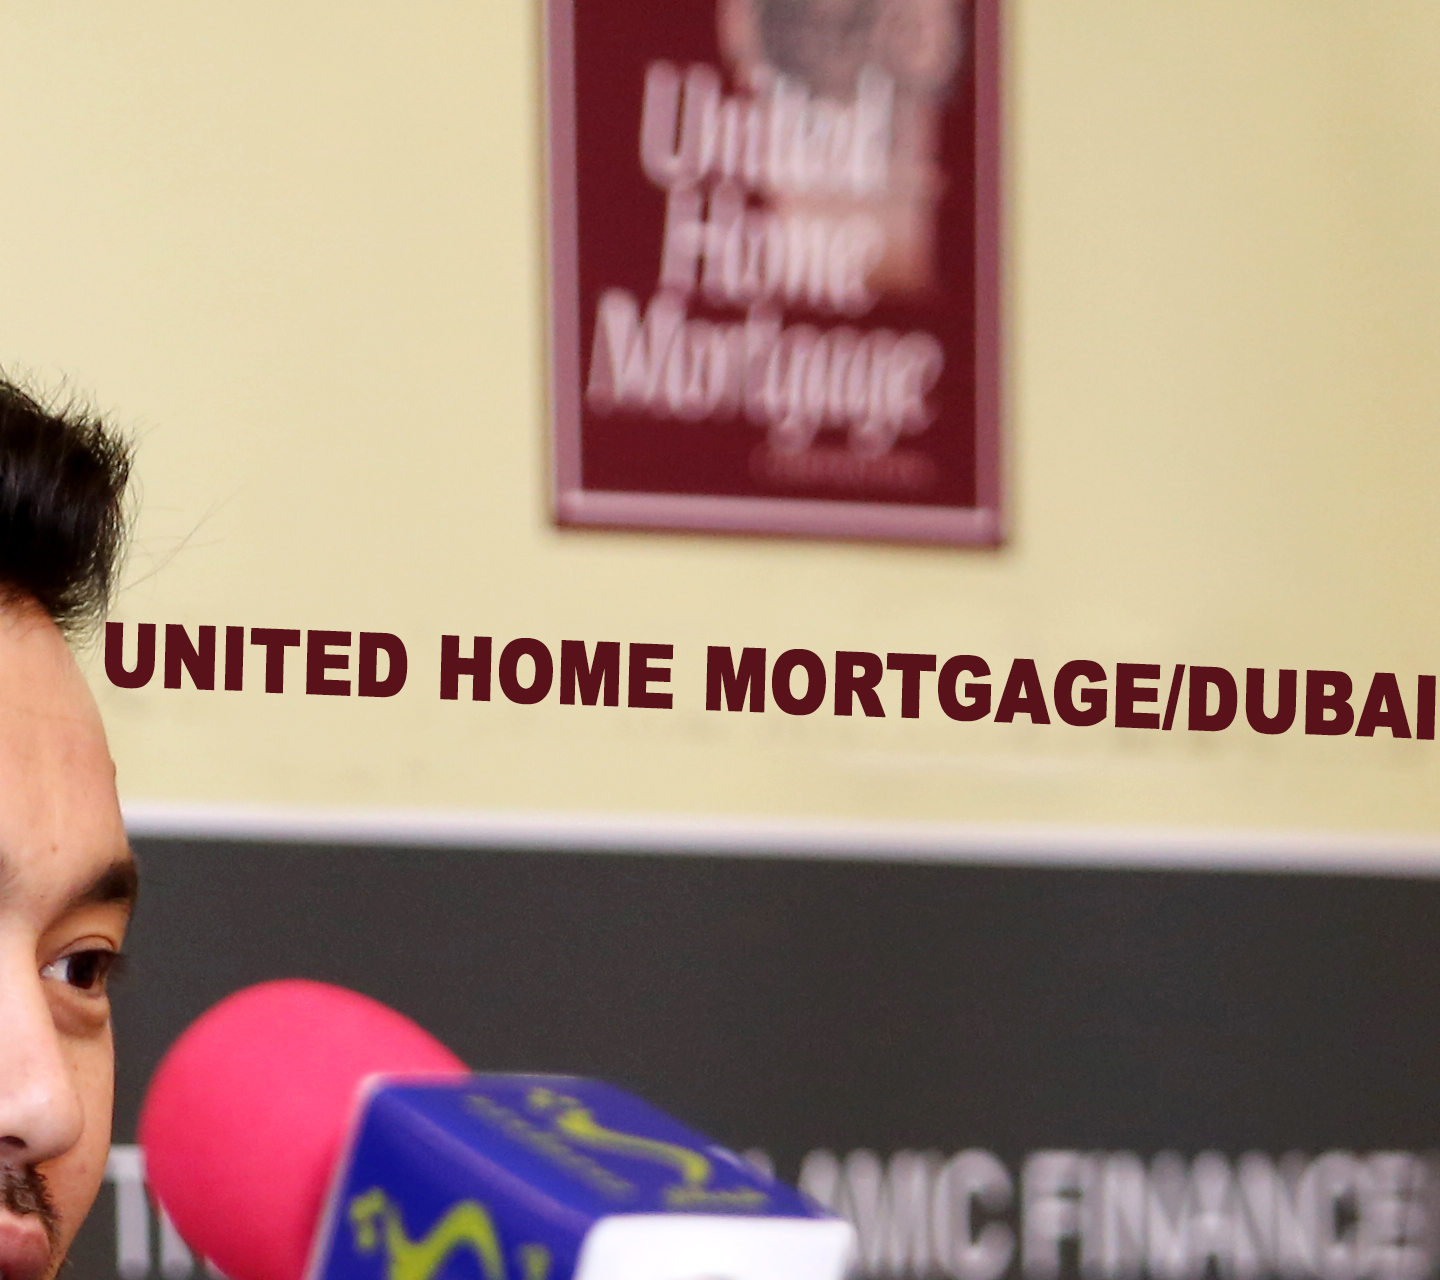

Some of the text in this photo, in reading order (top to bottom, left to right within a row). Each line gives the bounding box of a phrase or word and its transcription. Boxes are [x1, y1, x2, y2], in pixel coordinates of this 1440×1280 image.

[104, 621, 1437, 741] UNITED HOME MORTGAGE/DUBAI
